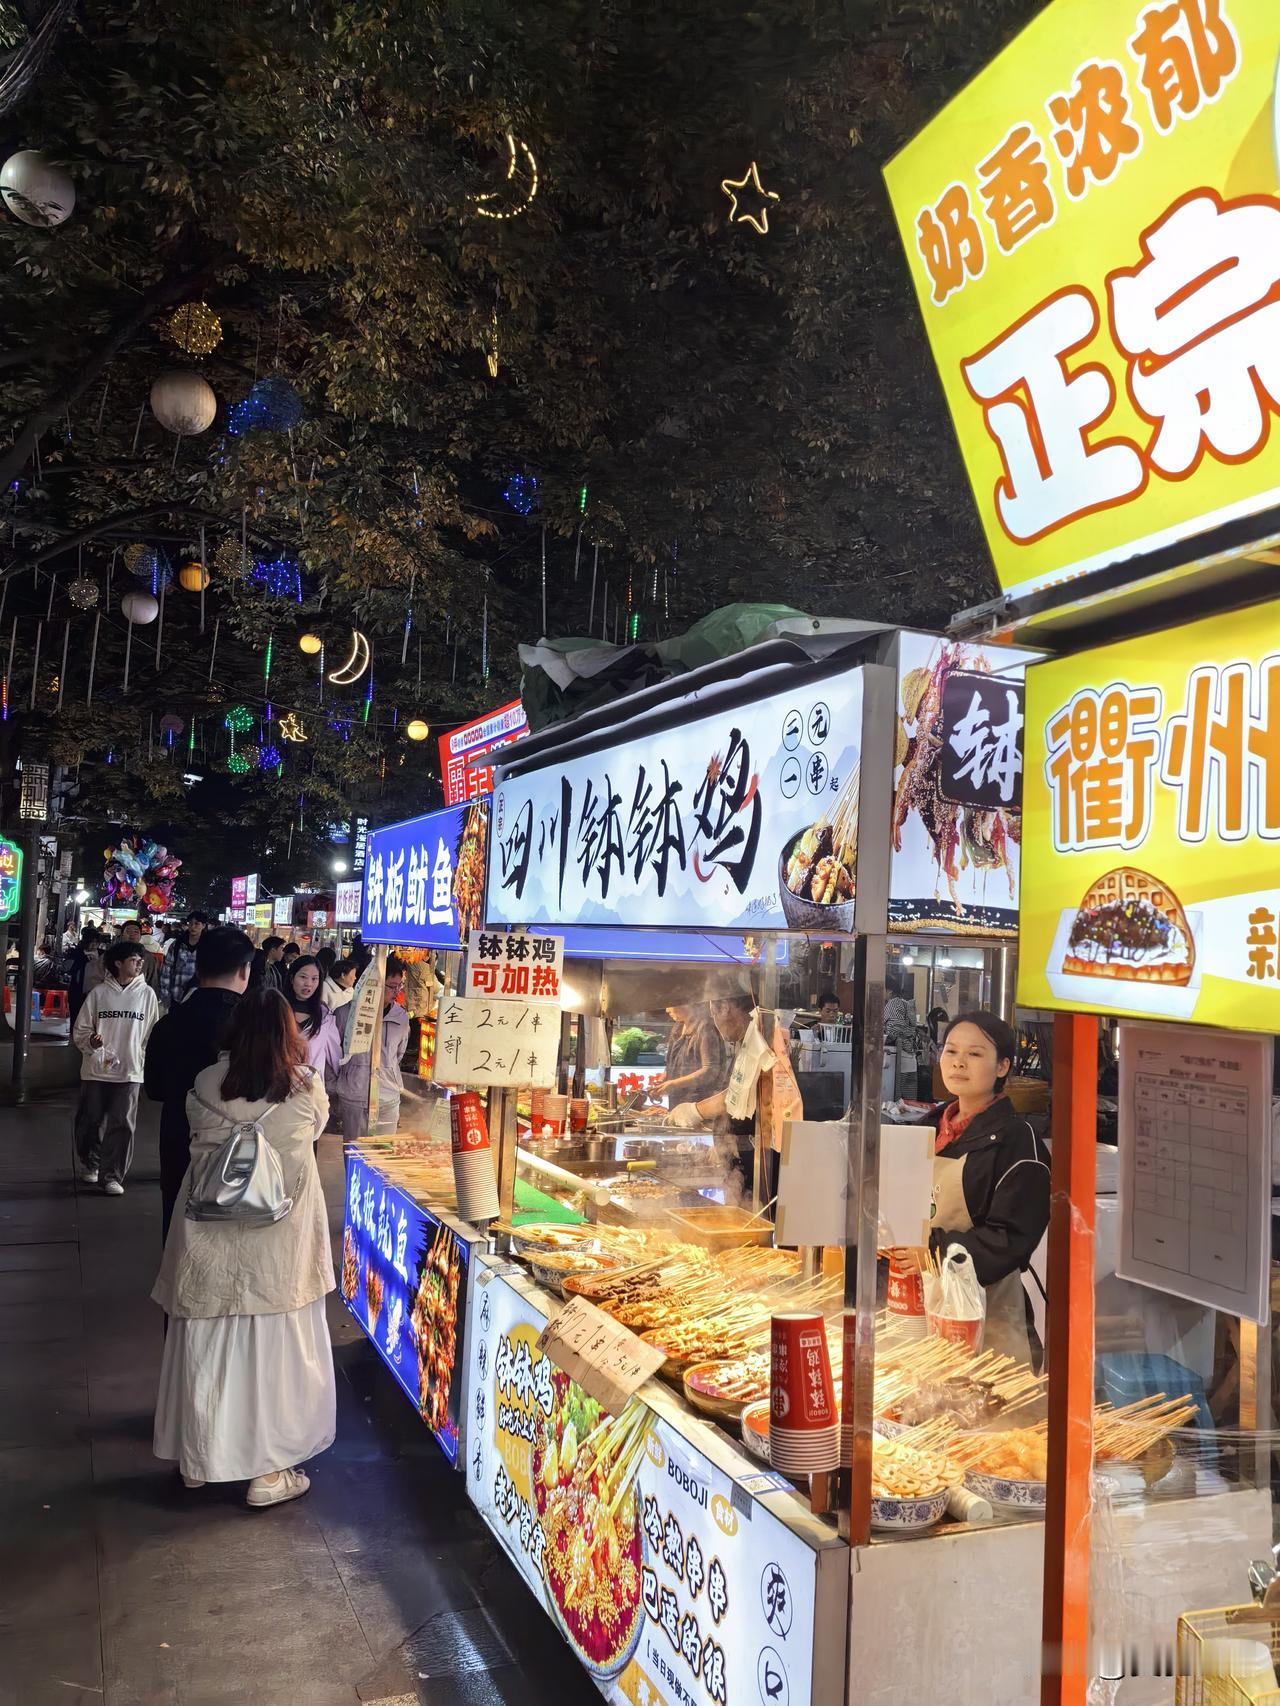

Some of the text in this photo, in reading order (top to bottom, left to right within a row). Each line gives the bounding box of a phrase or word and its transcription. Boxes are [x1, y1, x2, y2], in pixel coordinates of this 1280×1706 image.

[917, 0, 1238, 304] 奶香浓郁
[962, 187, 1280, 544] 正宗
[1045, 656, 1280, 853] 衢州
[500, 728, 763, 912] 四川钵钵鸡
[367, 836, 455, 926] 铁板鱿鱼
[471, 962, 560, 997] 可加热
[478, 933, 557, 964] 钵钵鸡
[98, 1010, 145, 1022] ESSENTIALS
[495, 1336, 554, 1418] 钵钵鸡
[667, 1456, 709, 1510] BOBOJI
[643, 1496, 729, 1624] 冷热串串
[641, 1566, 727, 1704] 巴适的很
